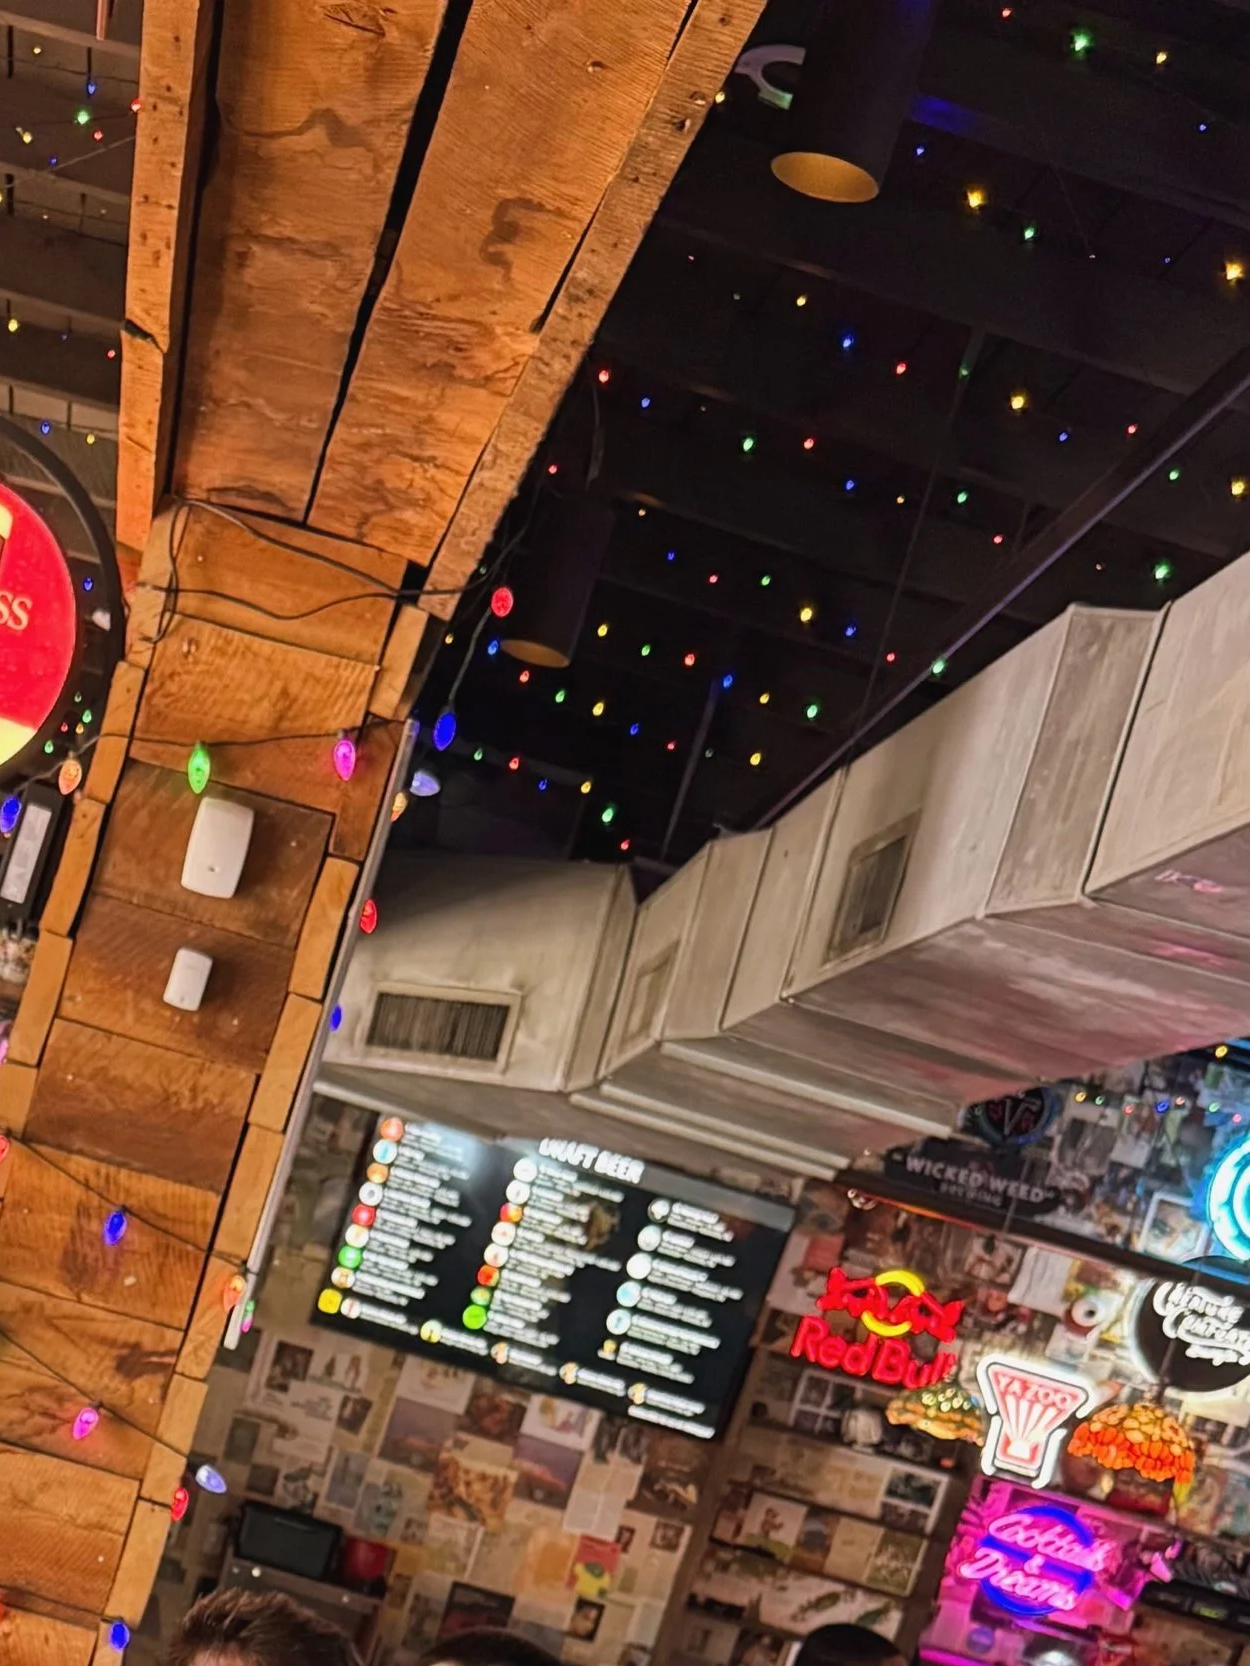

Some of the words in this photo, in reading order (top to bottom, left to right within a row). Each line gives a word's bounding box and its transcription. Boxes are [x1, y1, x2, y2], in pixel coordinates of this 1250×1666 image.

[906, 1155, 984, 1188] WICKED
[989, 1175, 1045, 1204] WEED
[790, 1315, 880, 1378] Red
[871, 1336, 959, 1391] Bull
[996, 1370, 1072, 1411] YAZOO
[959, 1547, 1078, 1611] Dreams
